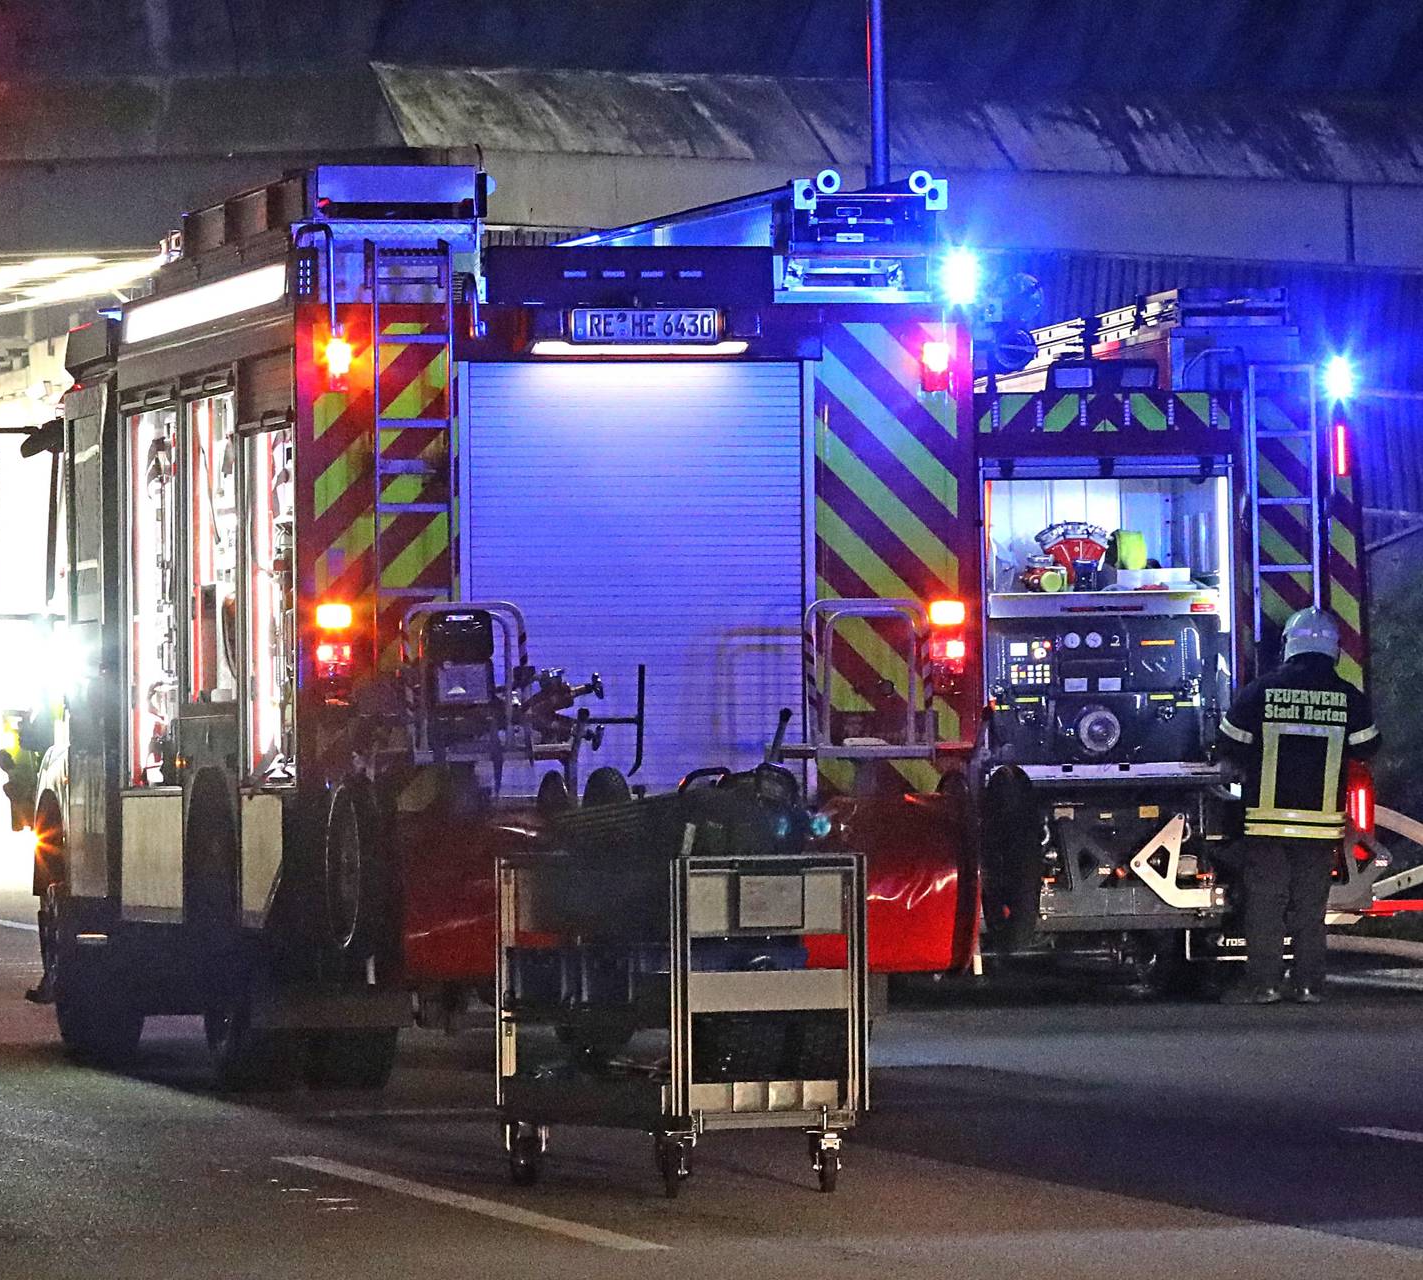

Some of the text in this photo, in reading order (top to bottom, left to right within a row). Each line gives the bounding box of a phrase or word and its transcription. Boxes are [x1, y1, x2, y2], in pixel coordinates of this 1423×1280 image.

[589, 314, 614, 337] RE
[631, 314, 657, 337] HE
[663, 314, 712, 337] 6430
[1264, 688, 1347, 707] FEUERWEHR
[1264, 703, 1347, 723] Stadt Herten
